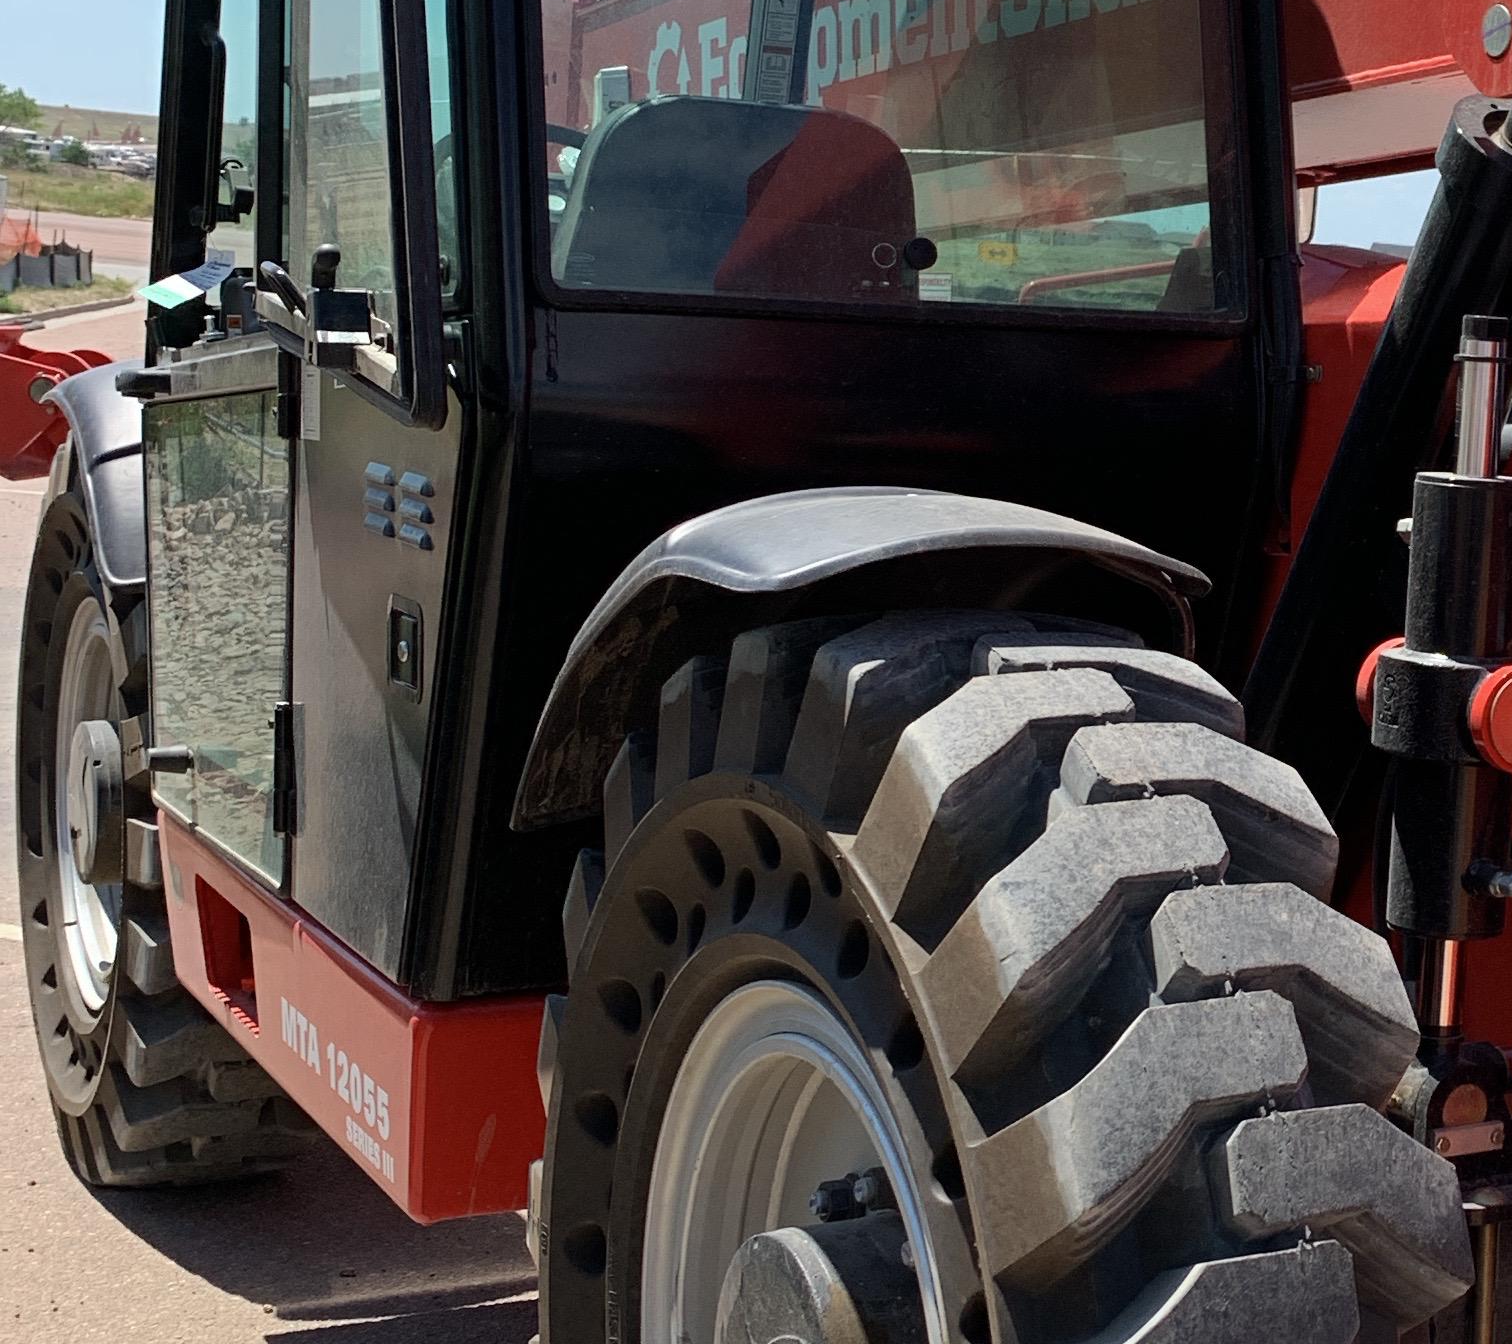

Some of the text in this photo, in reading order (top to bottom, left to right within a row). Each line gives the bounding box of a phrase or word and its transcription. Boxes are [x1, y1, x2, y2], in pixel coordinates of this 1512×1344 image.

[280, 995, 391, 1142] MTA 12055
[345, 1114, 381, 1171] SERIES
